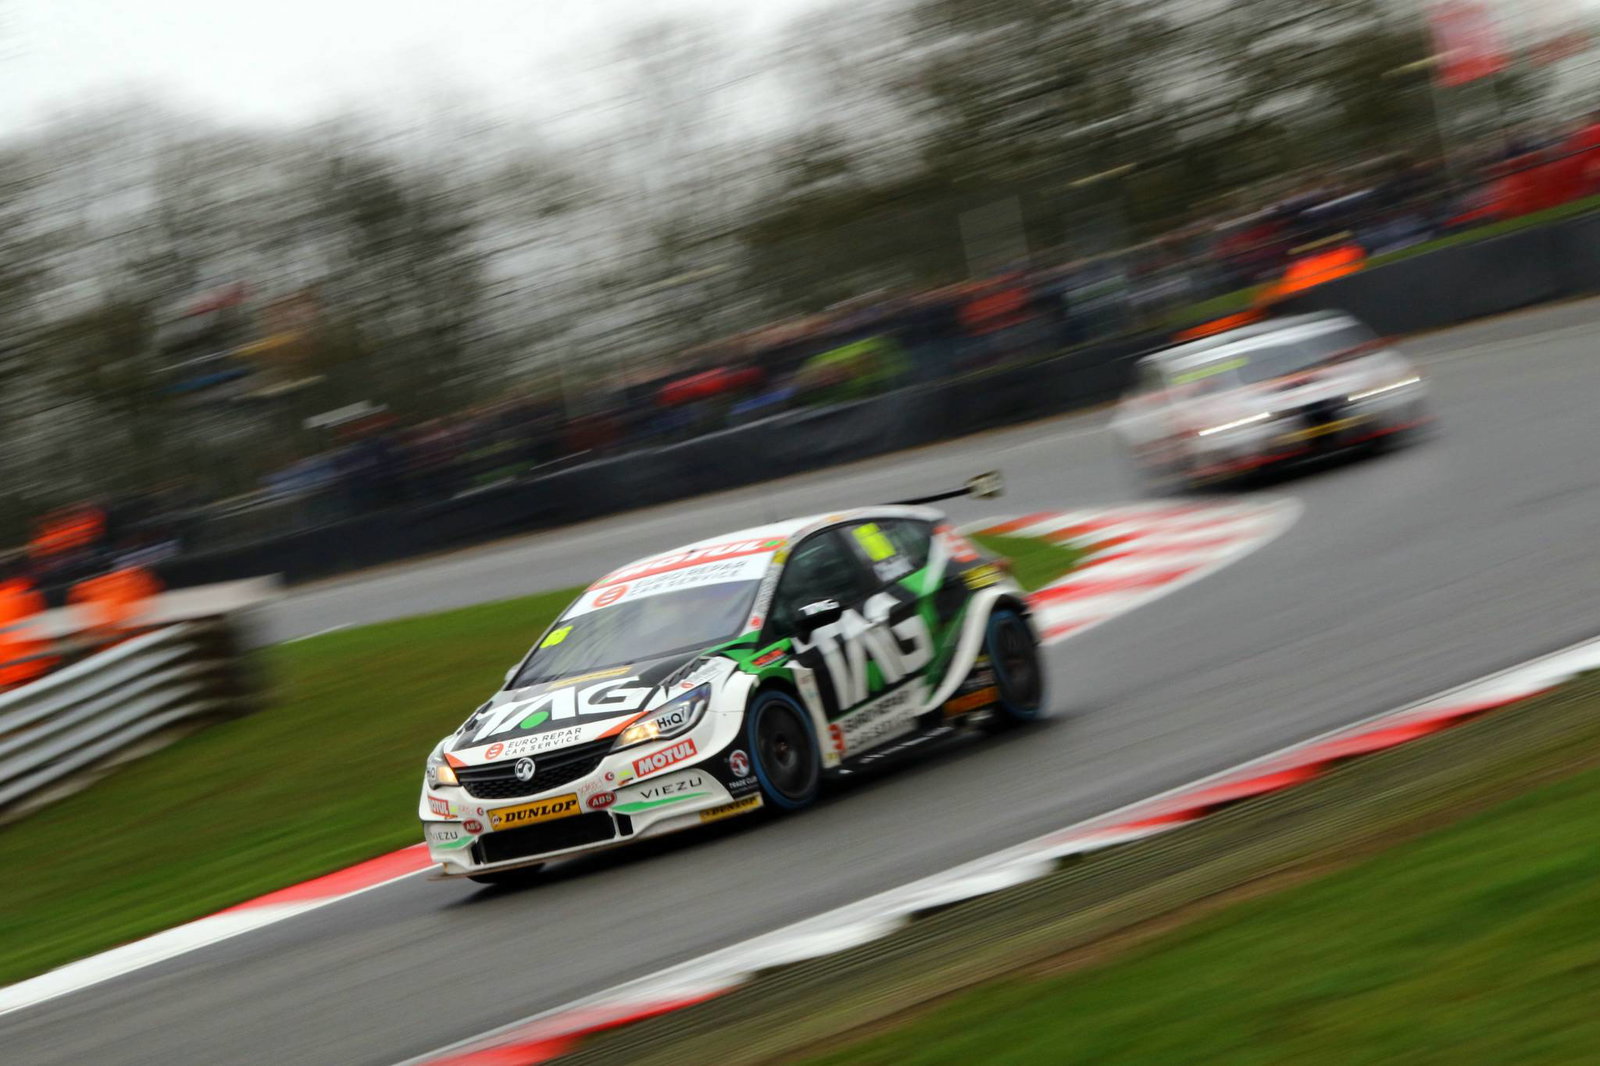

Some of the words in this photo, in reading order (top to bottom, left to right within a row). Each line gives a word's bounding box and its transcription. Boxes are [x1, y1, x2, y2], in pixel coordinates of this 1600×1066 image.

[471, 675, 657, 743] TAG
[656, 712, 683, 731] HiQ
[504, 745, 533, 757] CAR
[537, 734, 580, 751] SERVICE
[507, 736, 538, 749] EURO
[541, 727, 582, 742] REPAR
[638, 741, 694, 776] MOTUL
[640, 777, 703, 799] VIEZU
[592, 793, 613, 807] ABS
[504, 799, 578, 824] DUNLOP
